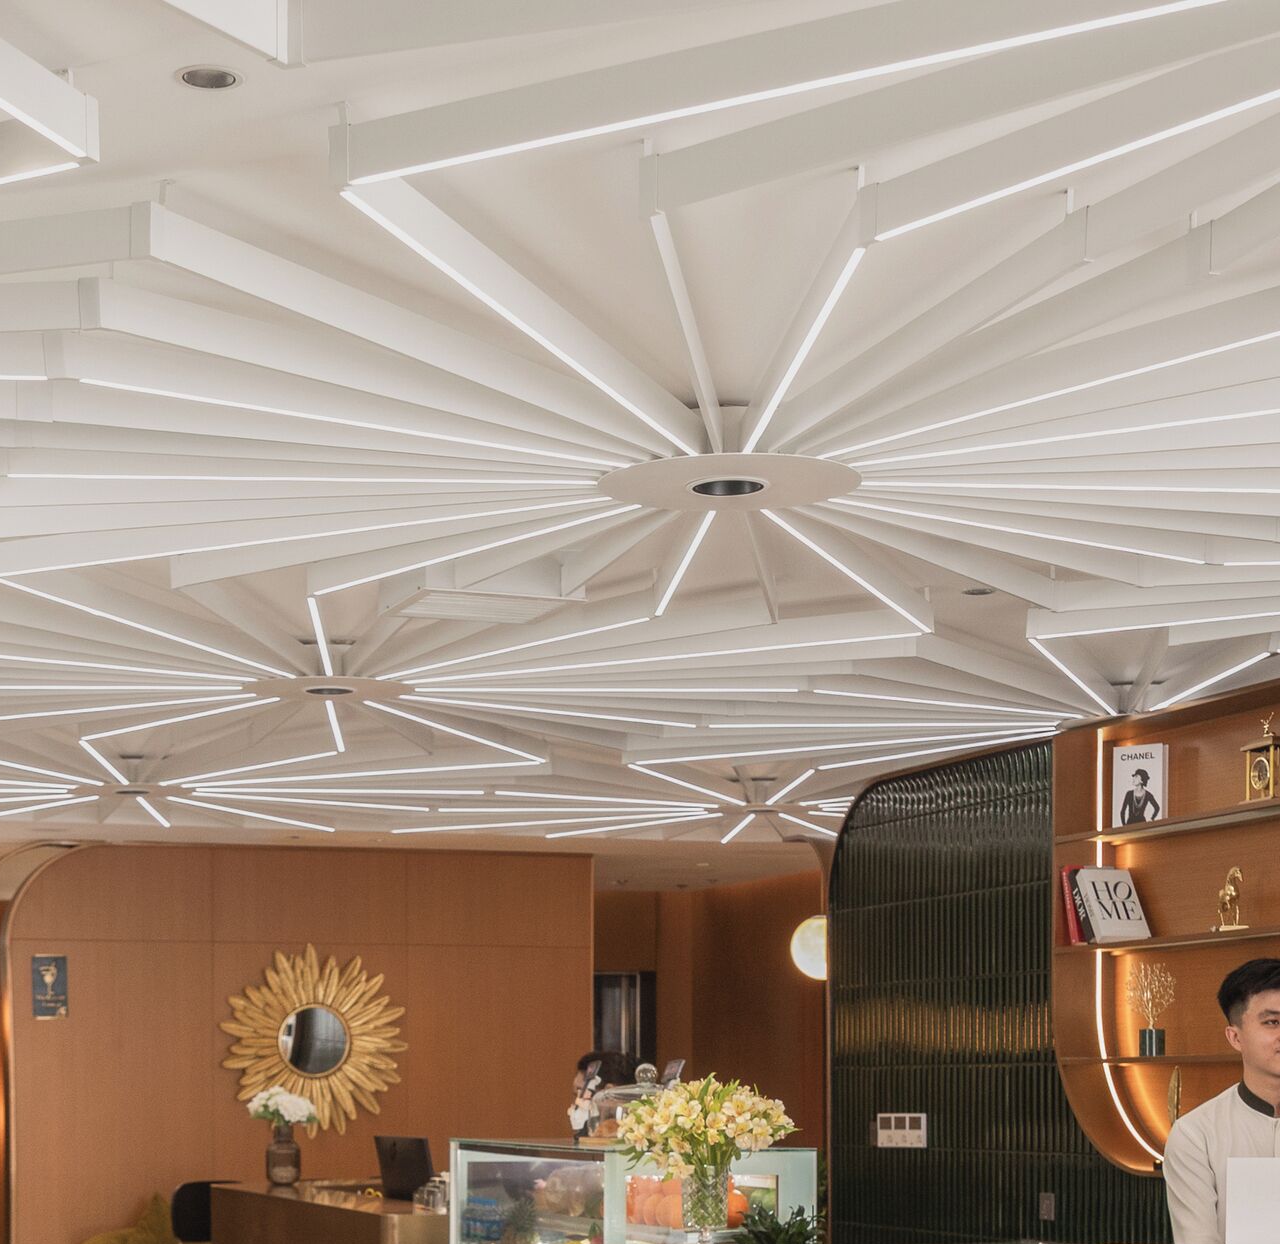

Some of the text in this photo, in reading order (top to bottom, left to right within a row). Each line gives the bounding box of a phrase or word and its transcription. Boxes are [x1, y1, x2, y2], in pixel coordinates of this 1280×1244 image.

[1120, 751, 1156, 761] CHANEL
[1091, 880, 1132, 901] HO
[1072, 887, 1086, 921] DIOR
[1098, 900, 1143, 920] ME
